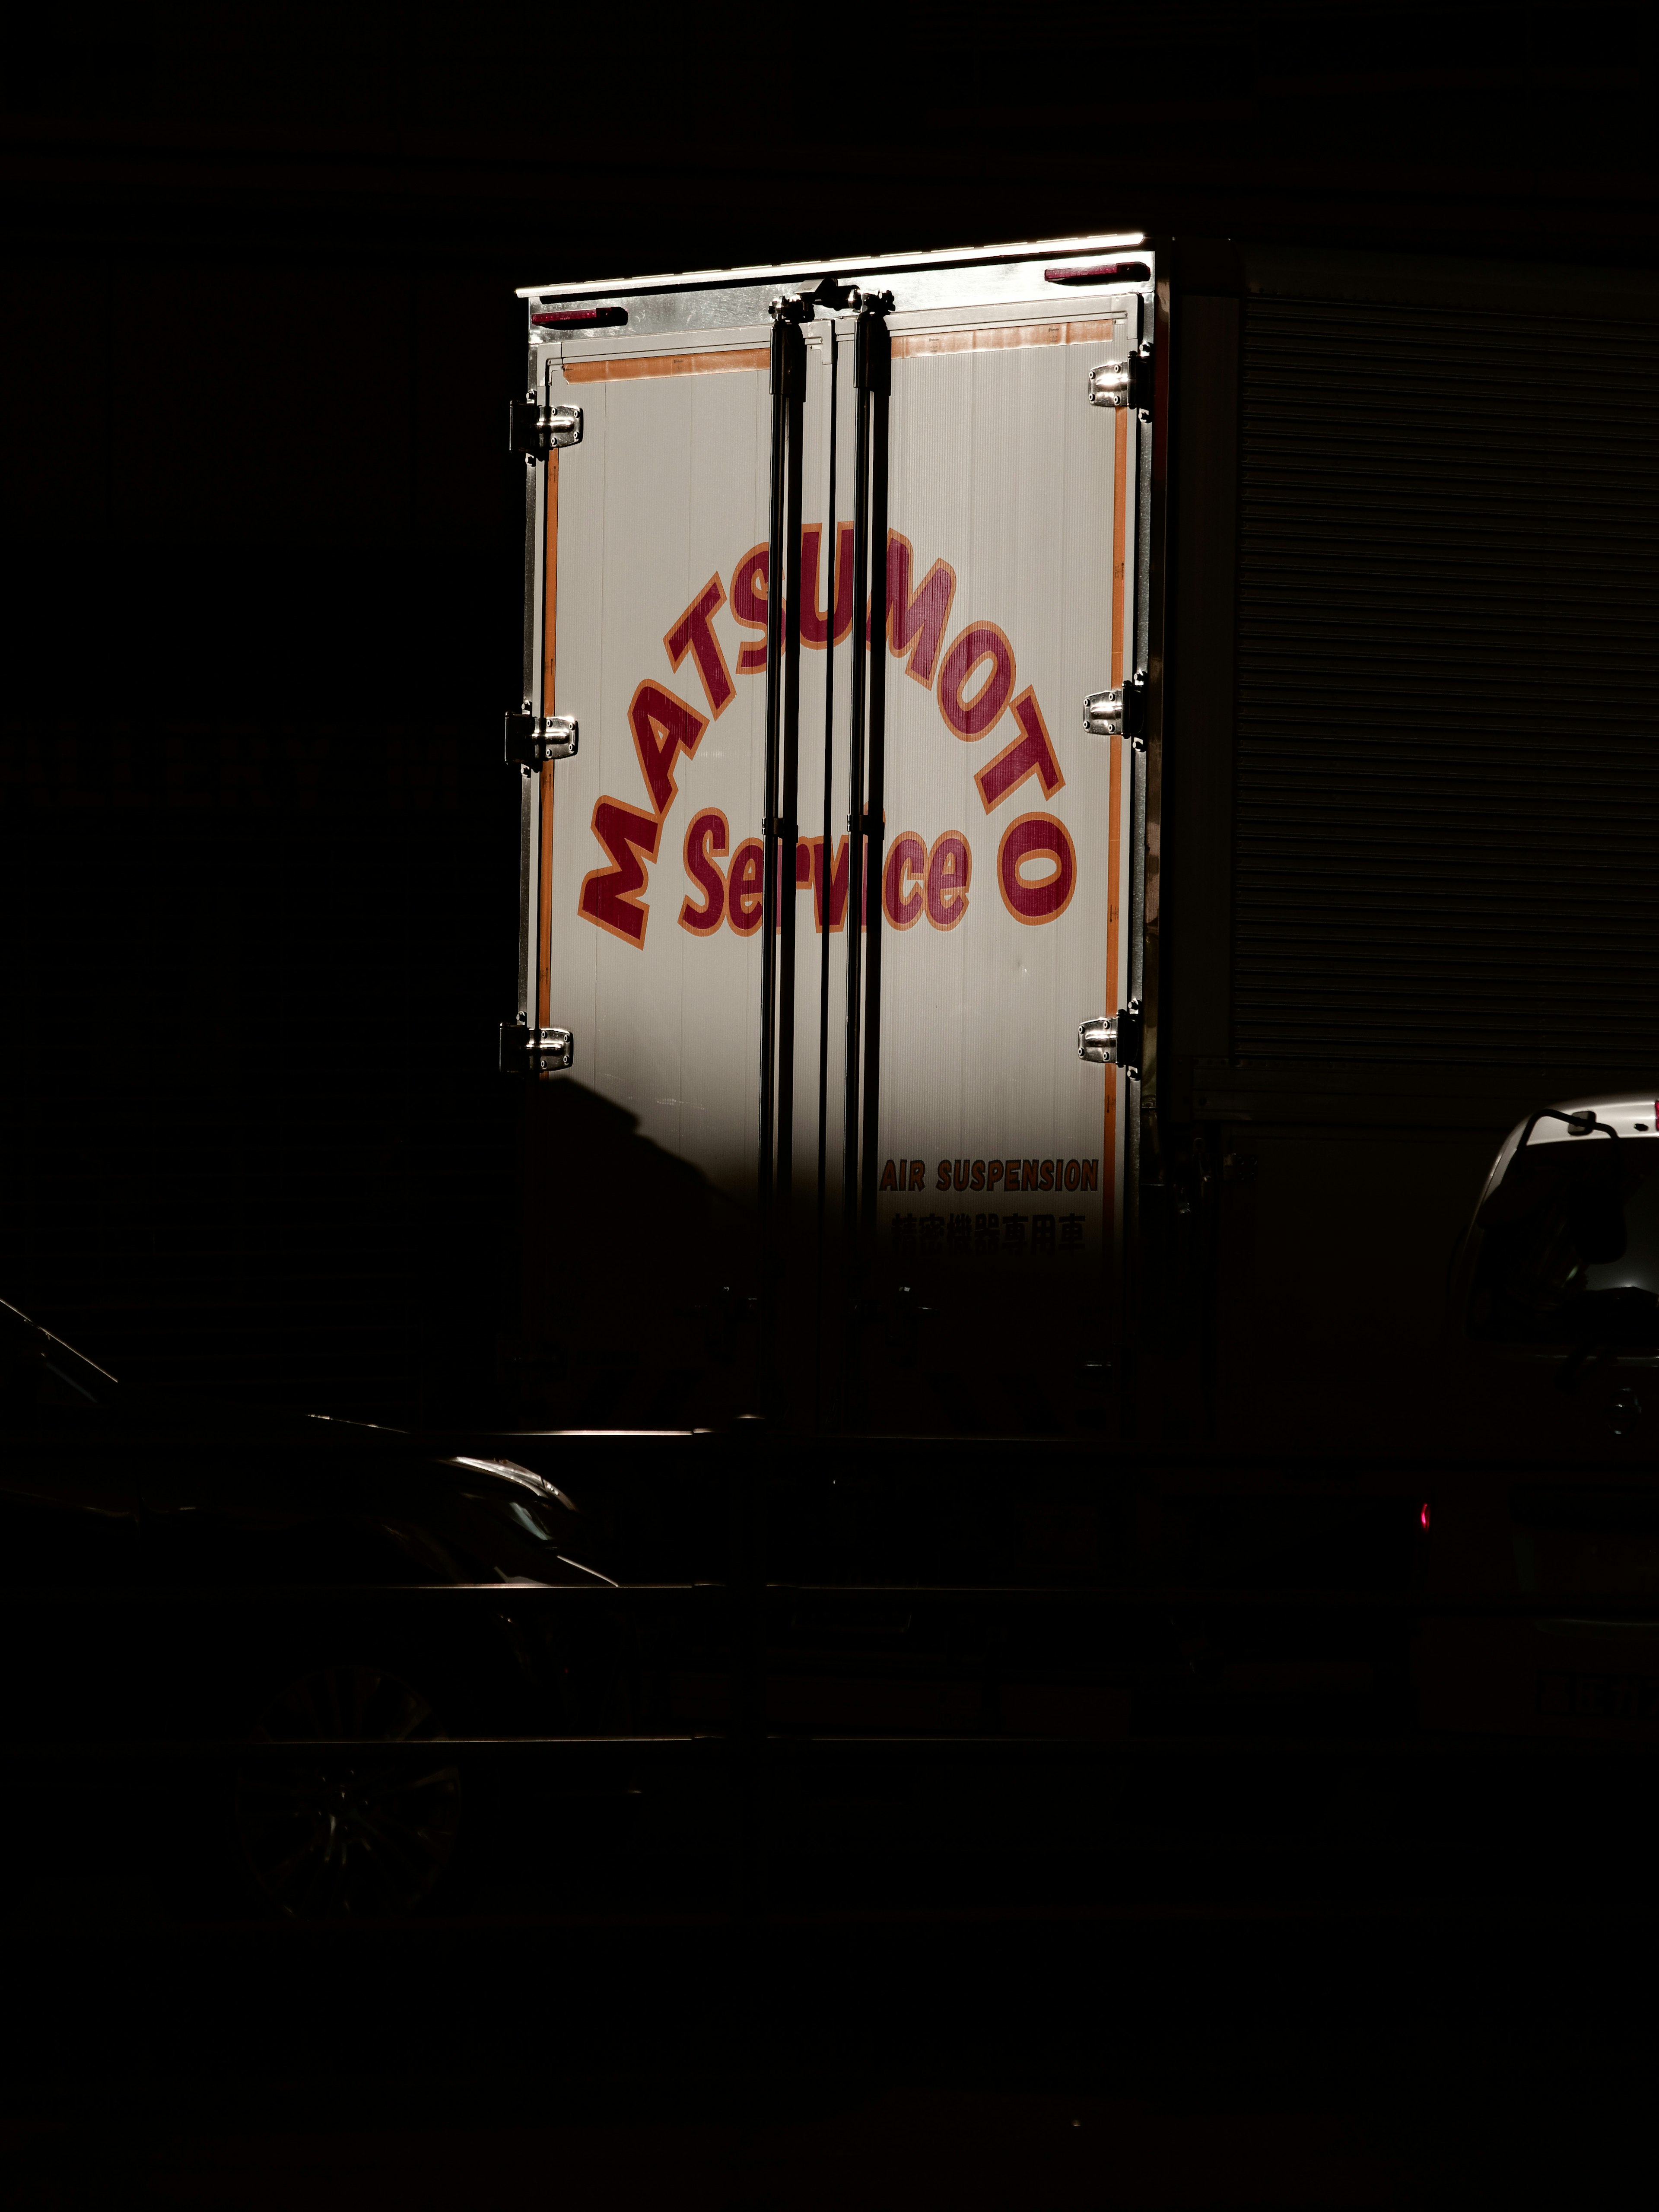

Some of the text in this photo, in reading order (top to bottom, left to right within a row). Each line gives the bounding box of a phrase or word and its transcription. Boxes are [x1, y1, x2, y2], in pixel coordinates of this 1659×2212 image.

[577, 521, 1077, 950] MATSUMOTO
[879, 1159, 1099, 1192] AIR SUSPENSION
